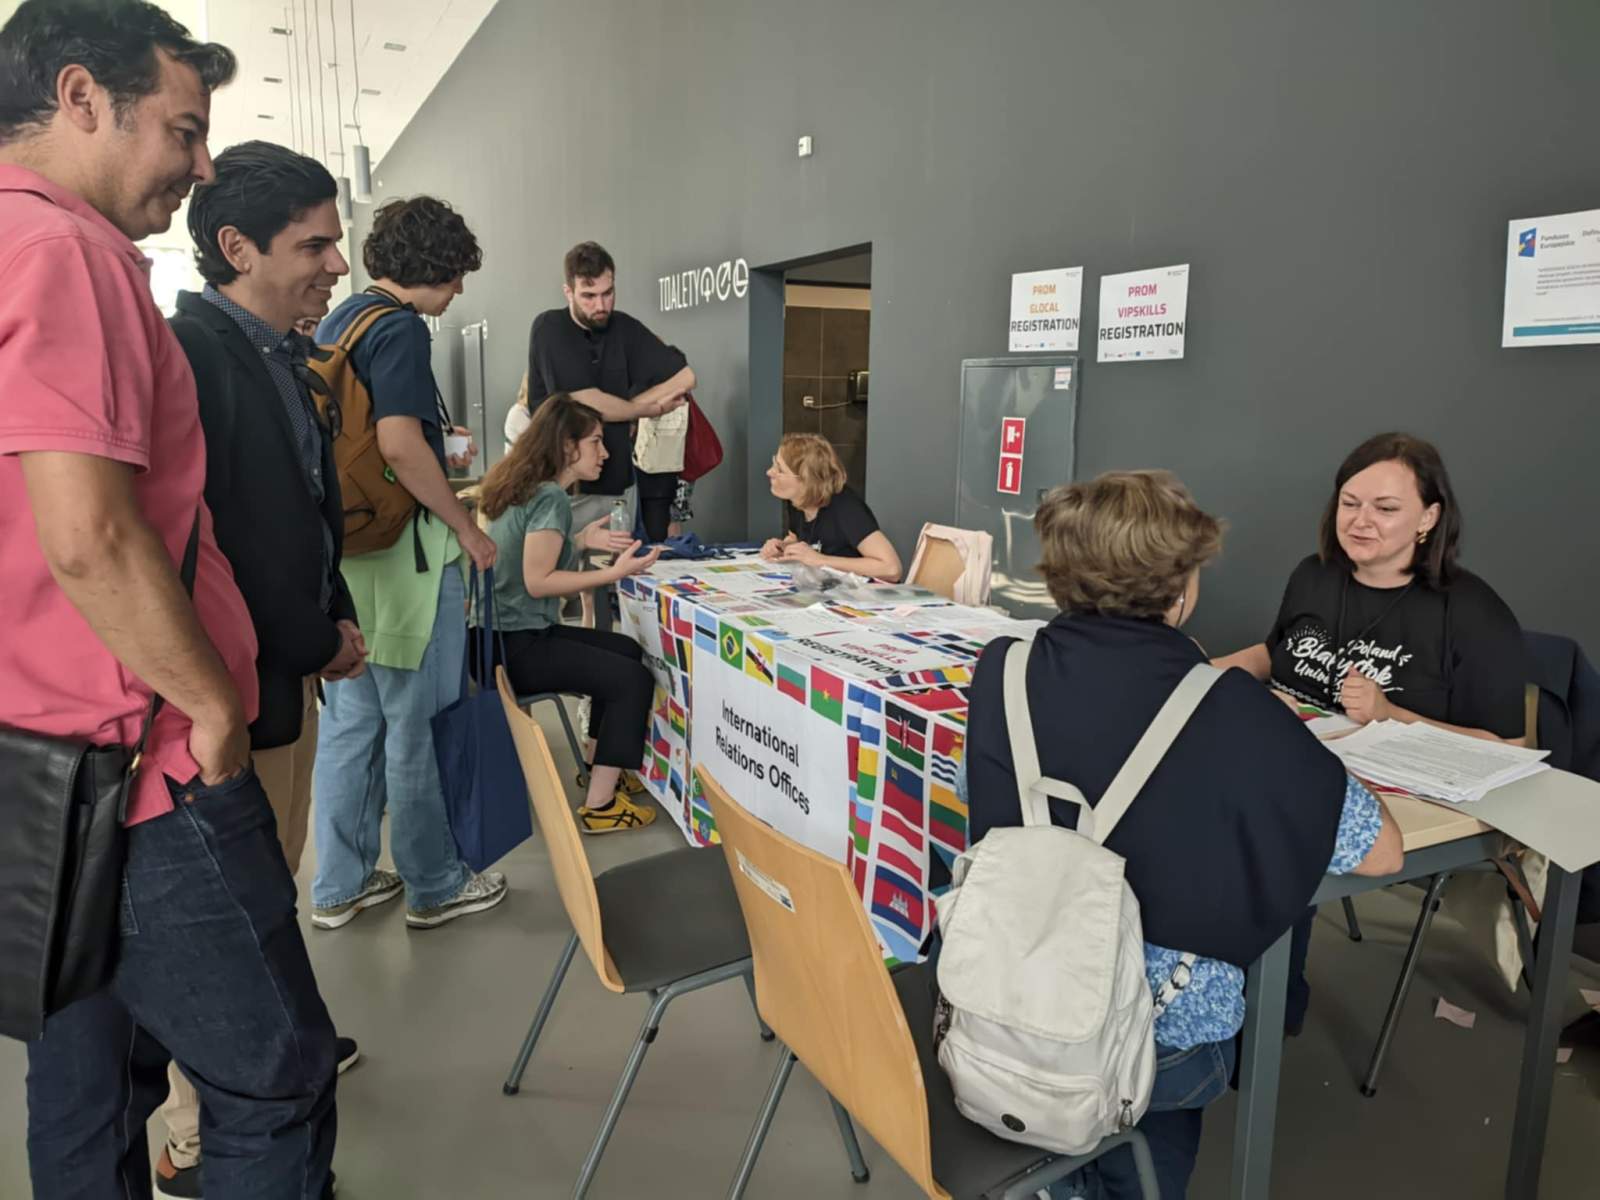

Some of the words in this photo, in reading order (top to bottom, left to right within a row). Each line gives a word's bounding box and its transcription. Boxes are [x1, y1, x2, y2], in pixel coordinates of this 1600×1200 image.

[658, 268, 701, 312] TOALETY
[1032, 284, 1057, 296] PROM
[1127, 283, 1158, 298] PROM
[1029, 302, 1060, 314] GLOCAL
[1117, 303, 1168, 318] VIPSKILLS
[1010, 317, 1079, 333] REGISTRATION
[1099, 321, 1184, 341] REGISTRATION
[1347, 640, 1403, 662] Poland
[721, 697, 800, 768] International
[715, 725, 765, 781] Relations
[768, 764, 811, 816] Offices
